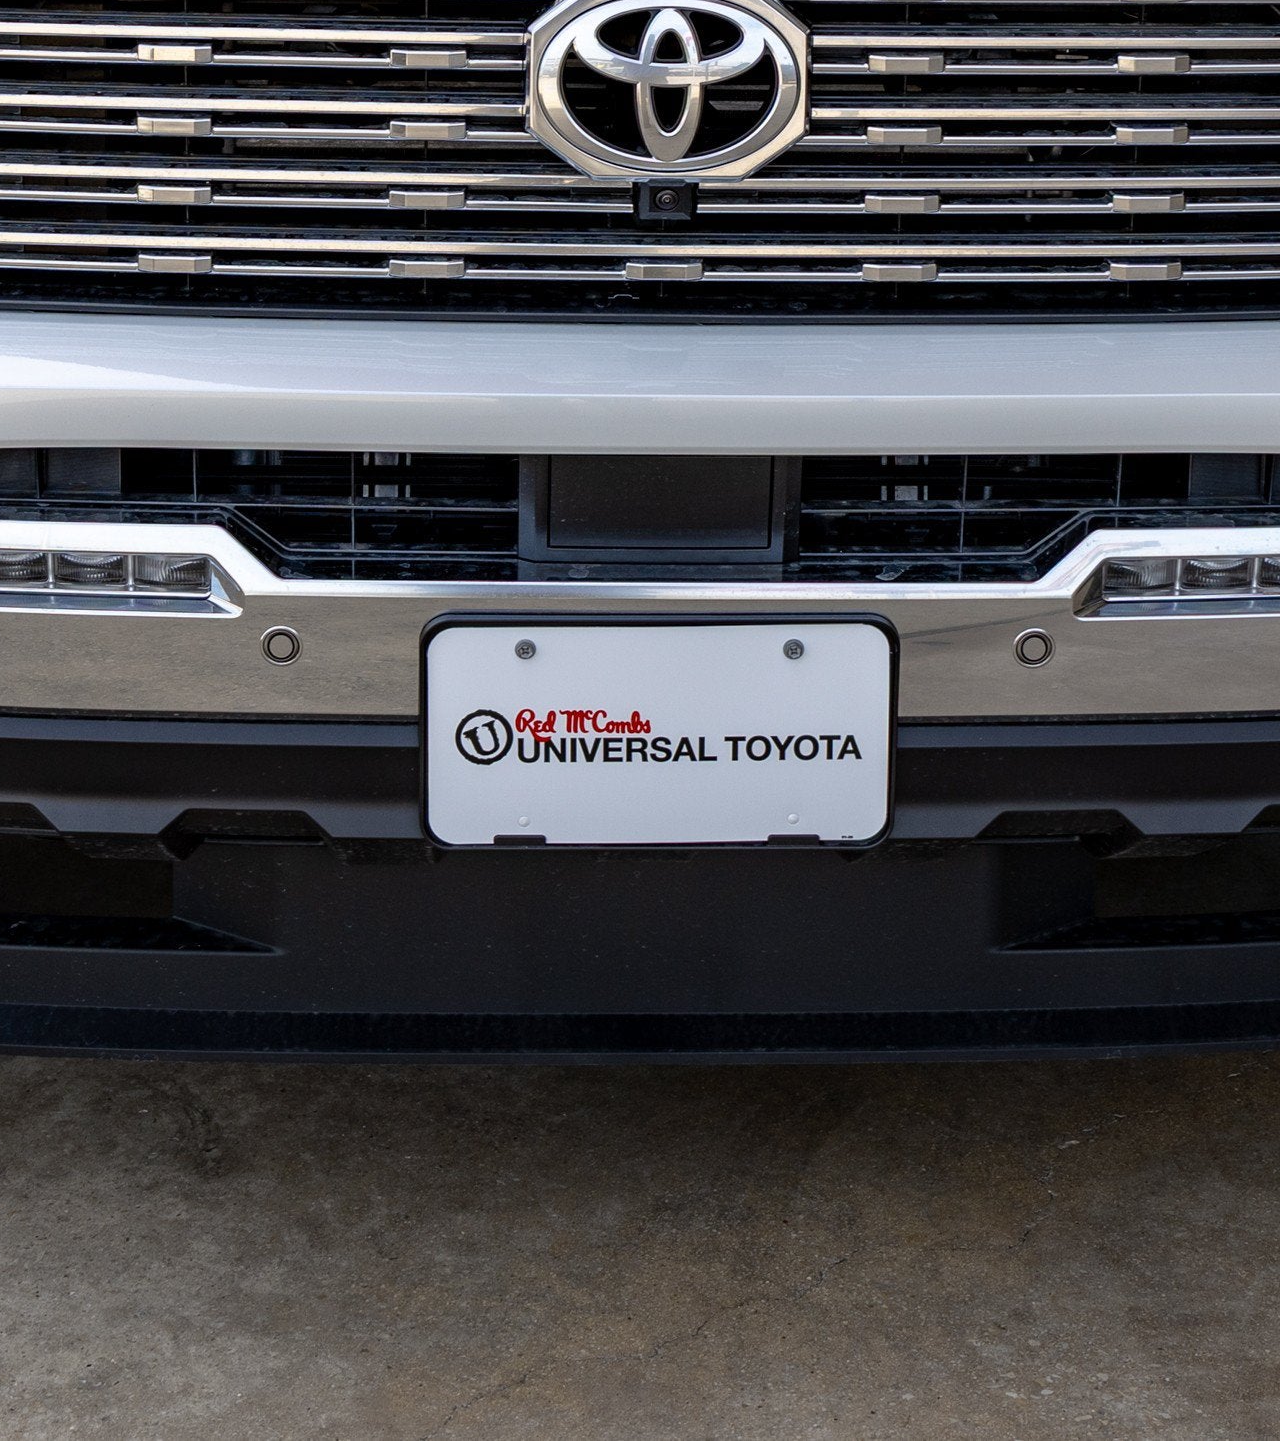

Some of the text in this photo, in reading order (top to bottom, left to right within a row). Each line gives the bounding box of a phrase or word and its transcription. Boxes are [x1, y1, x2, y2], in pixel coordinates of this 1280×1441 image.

[516, 709, 651, 743] Red McCombs
[517, 734, 862, 763] UNIVERSAL TOYOTA
